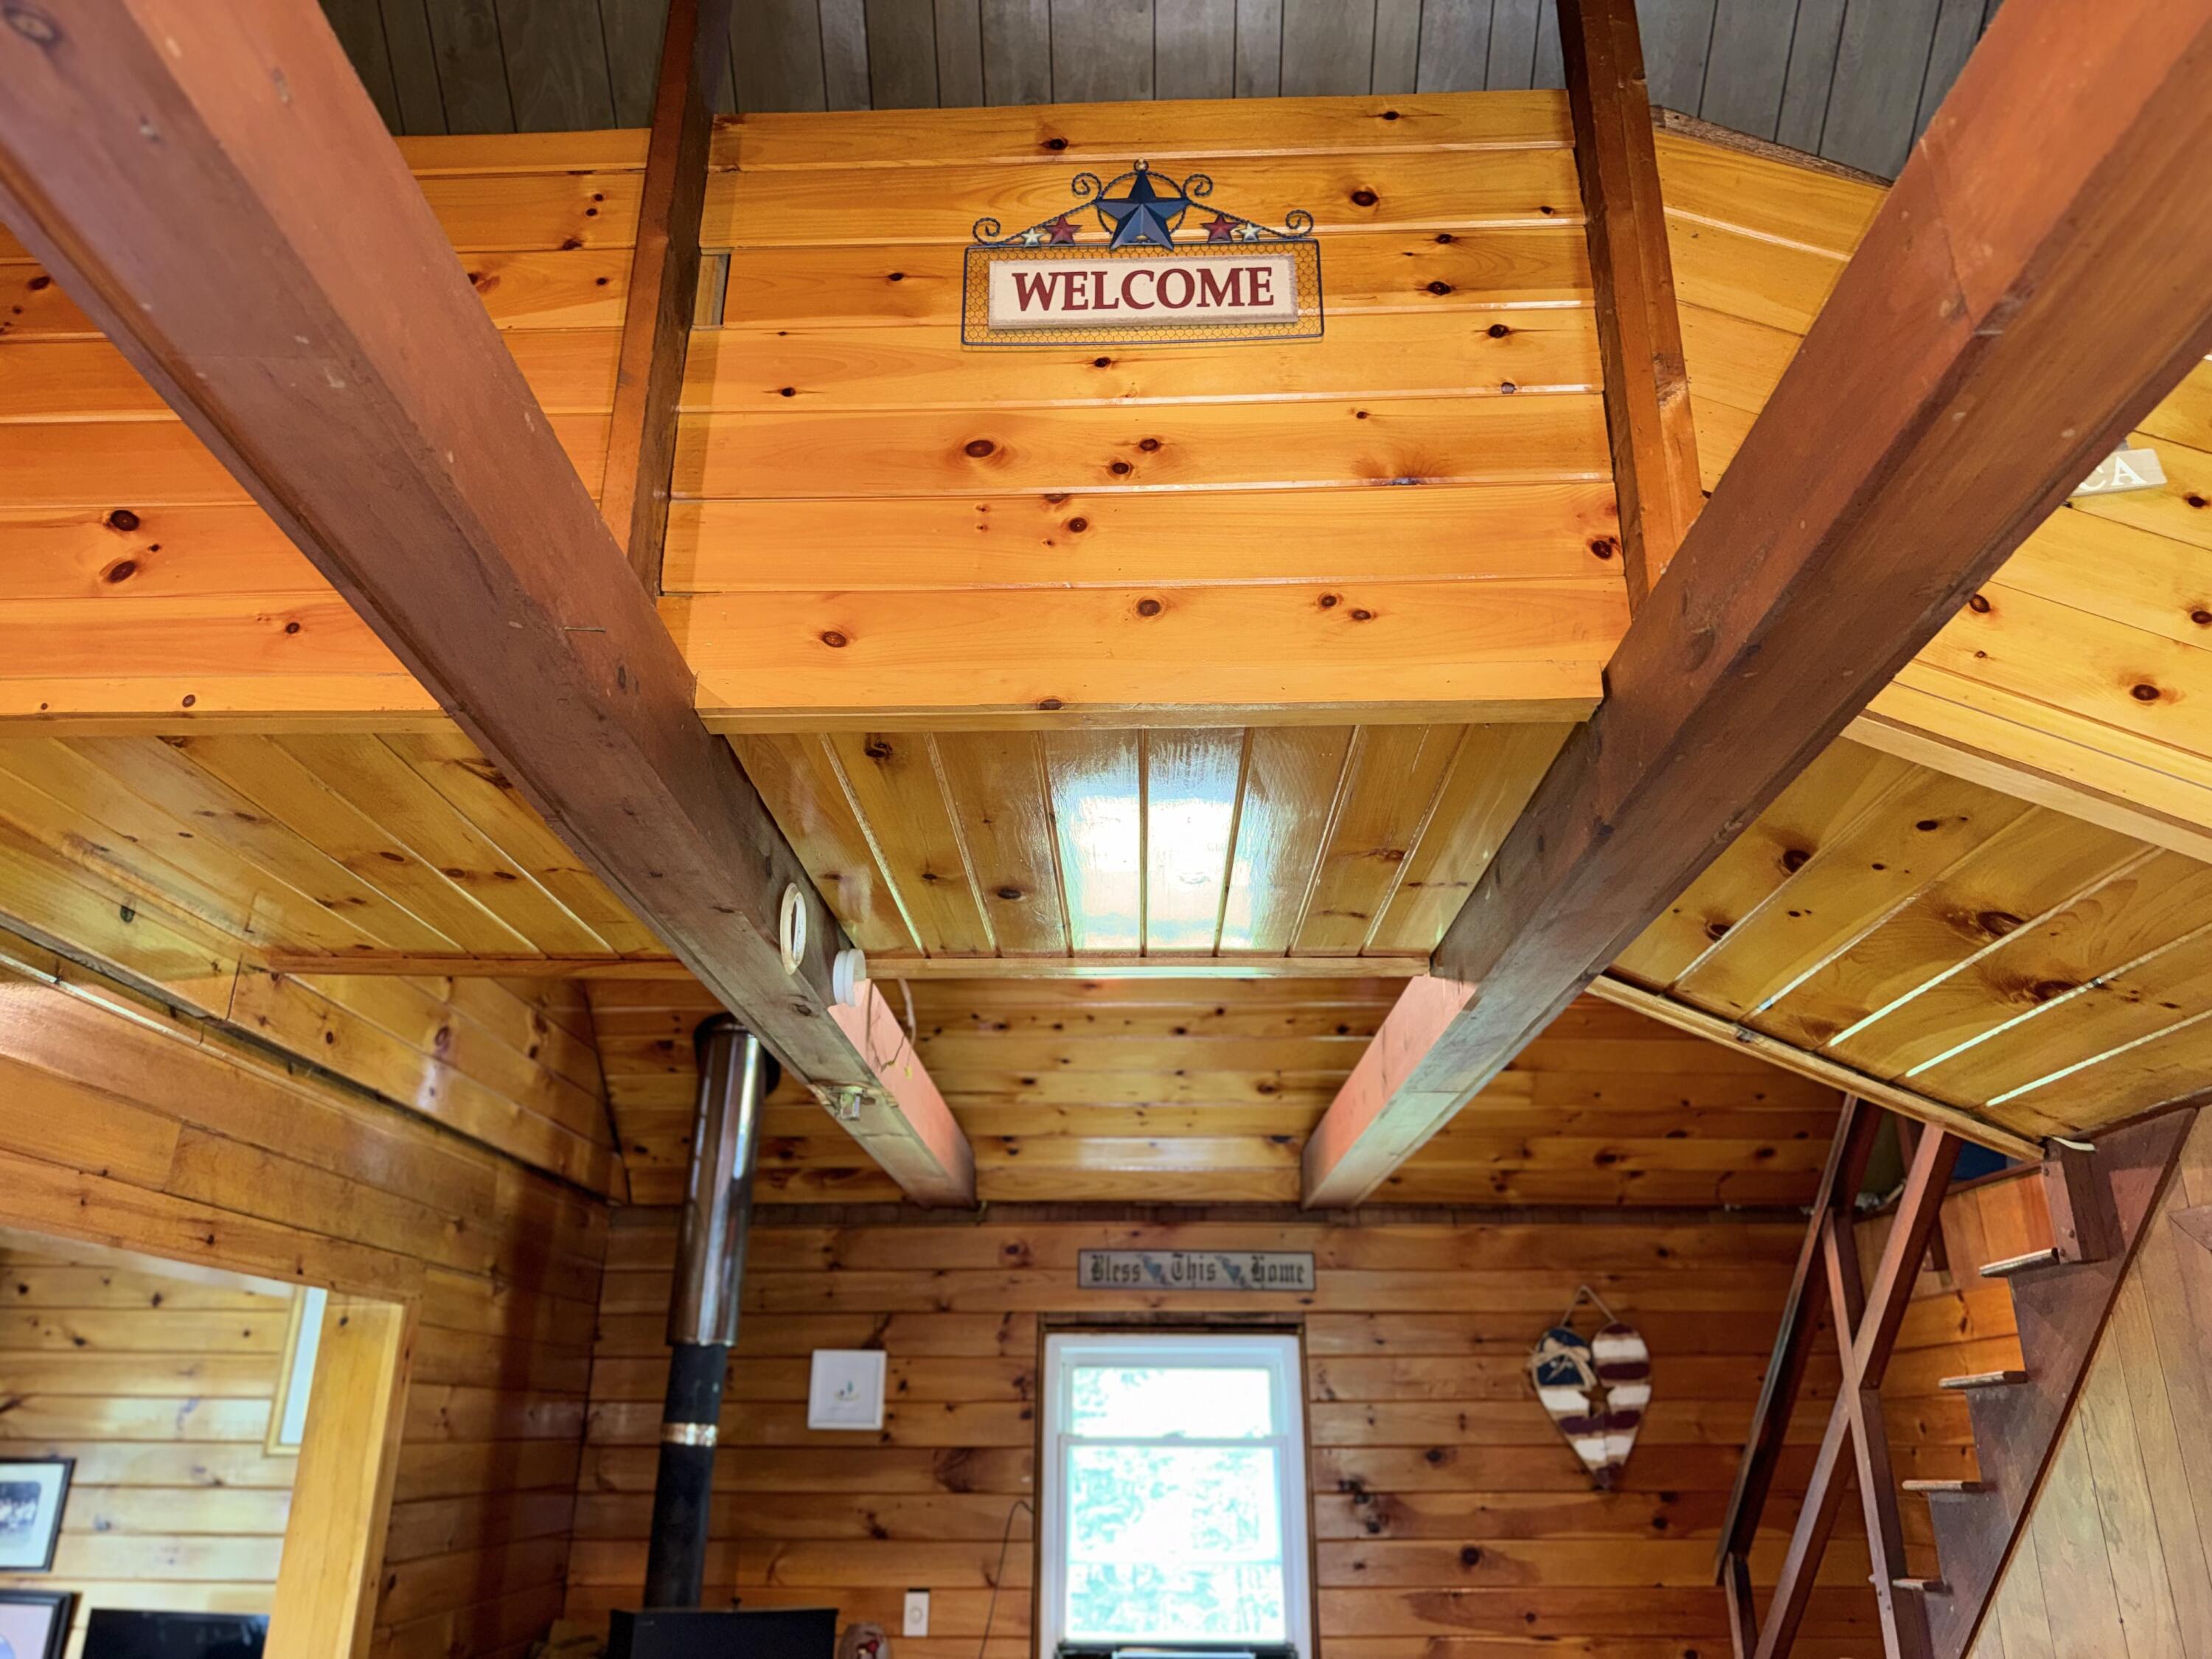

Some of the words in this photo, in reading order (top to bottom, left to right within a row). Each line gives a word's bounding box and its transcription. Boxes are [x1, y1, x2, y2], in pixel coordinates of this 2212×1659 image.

[1011, 266, 1275, 312] WELCOME
[1091, 1254, 1141, 1283] Bless
[1171, 1253, 1217, 1287] This
[1250, 1254, 1304, 1288] Home
